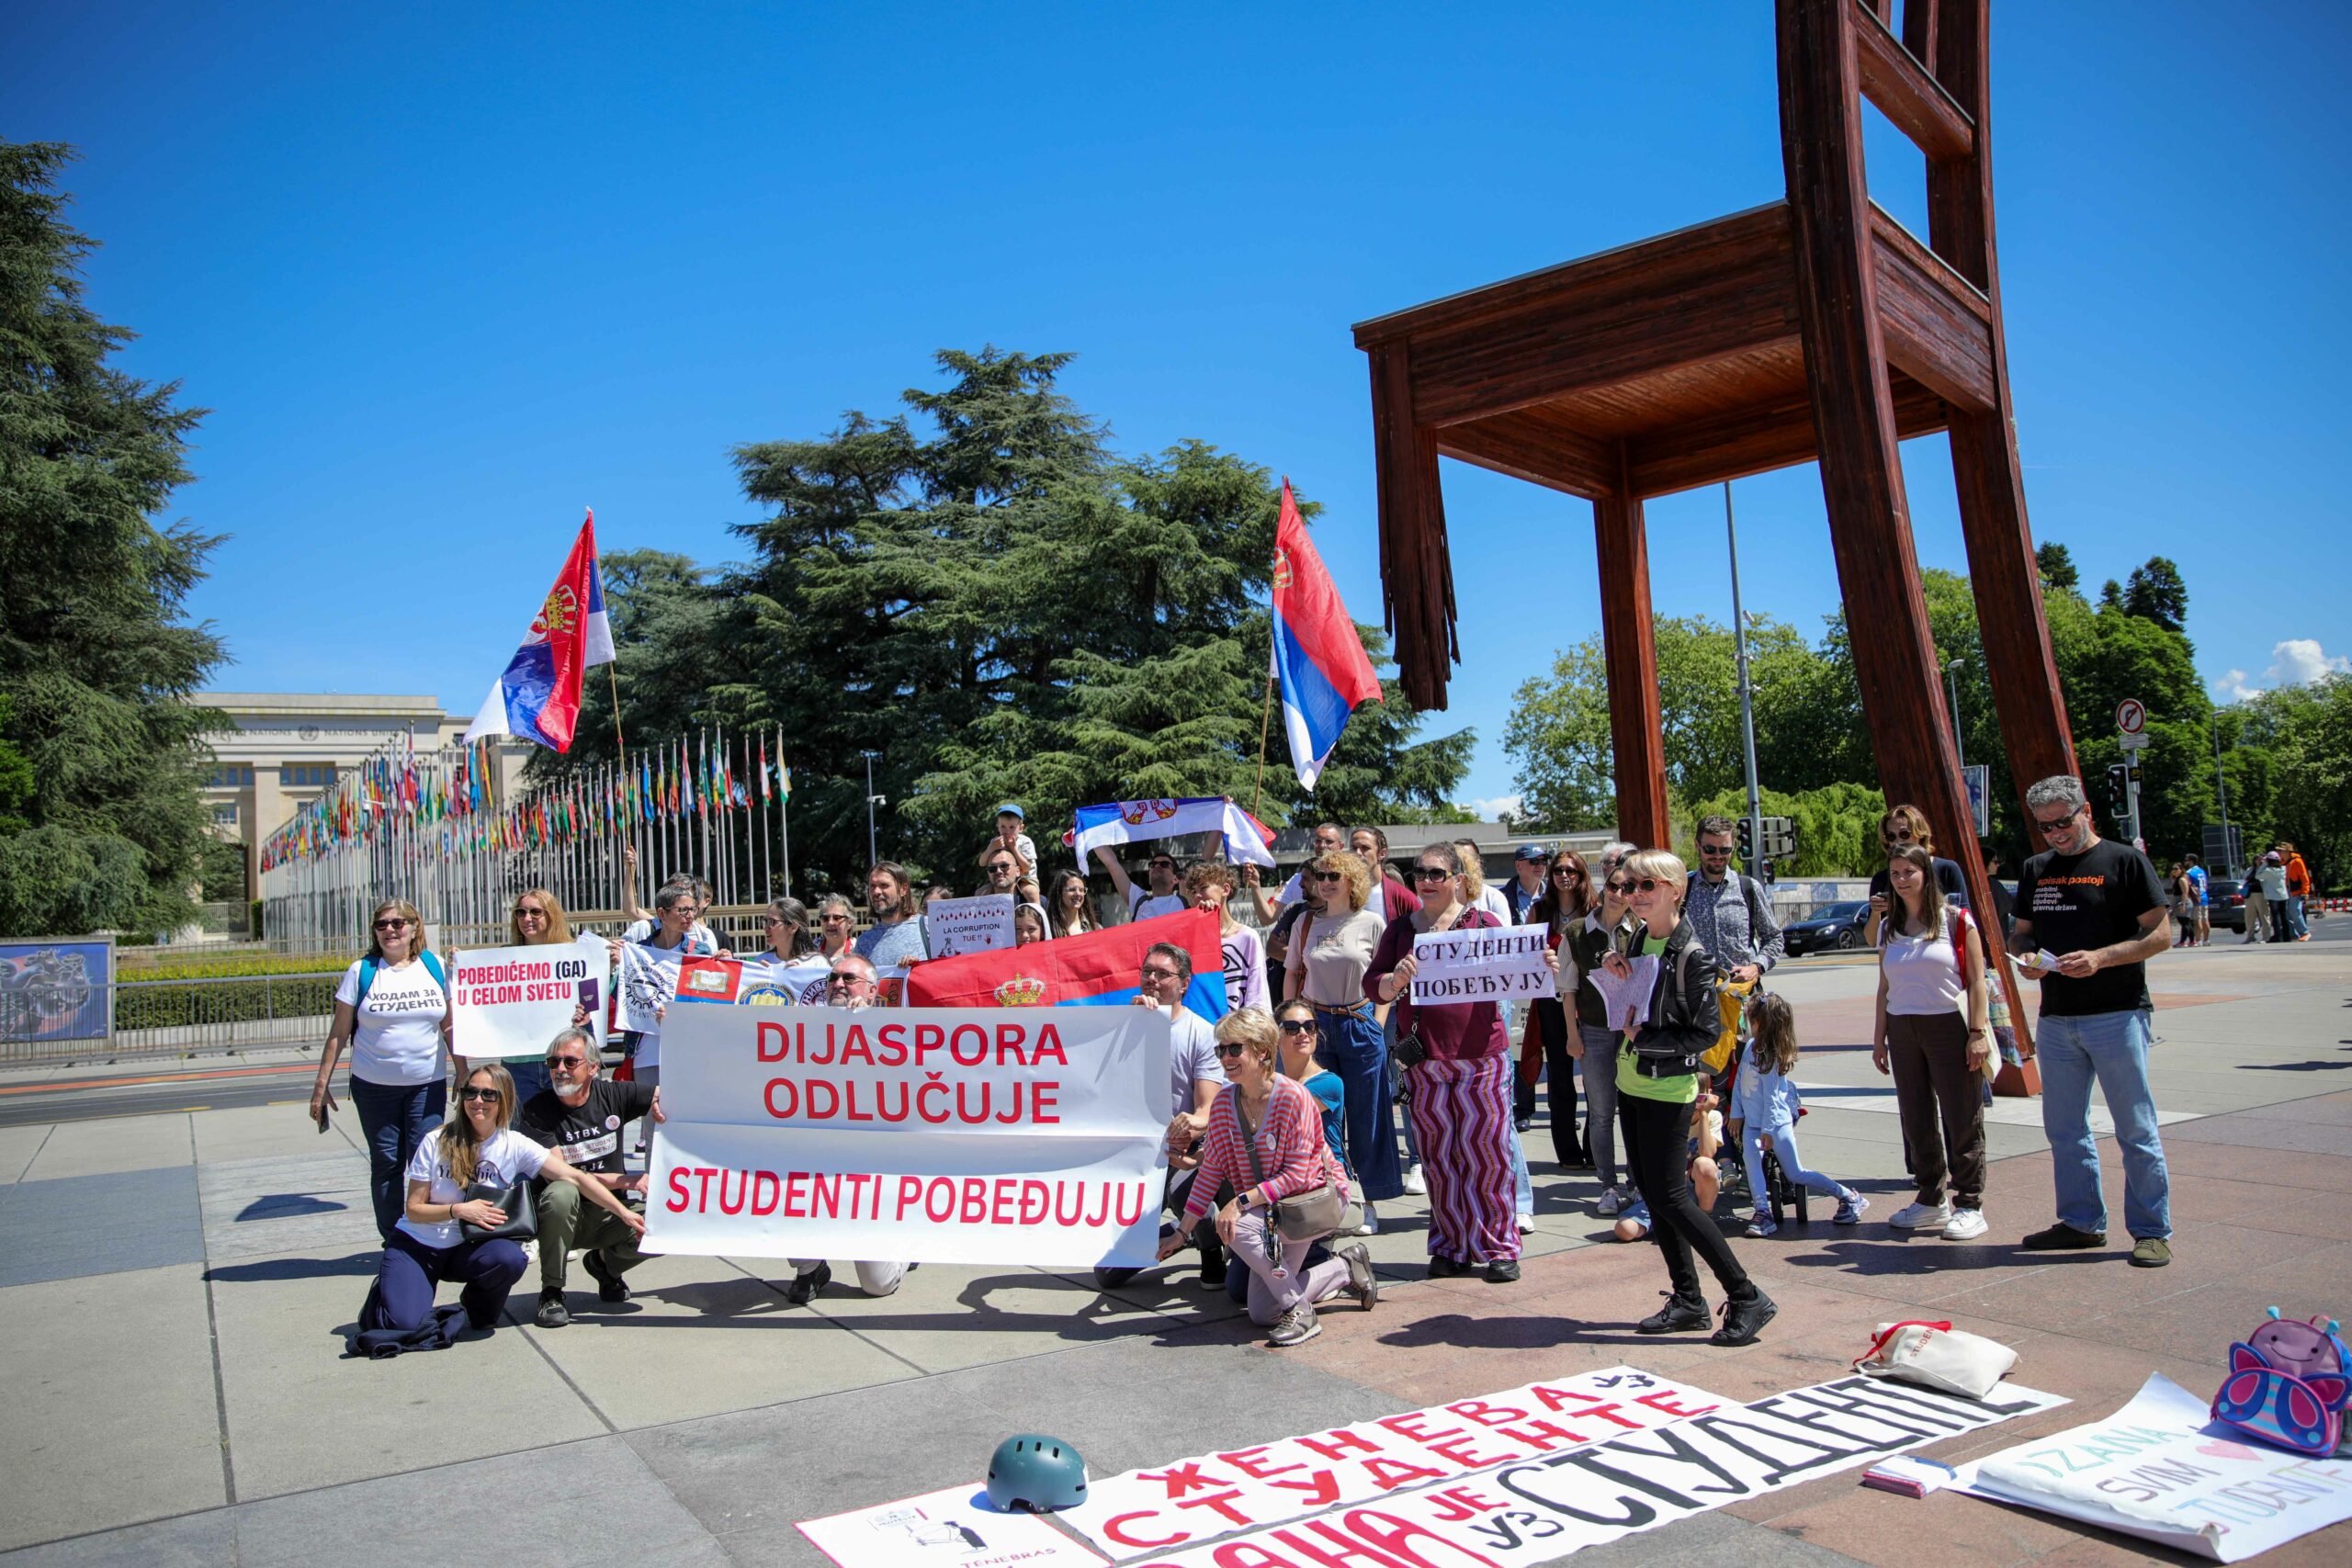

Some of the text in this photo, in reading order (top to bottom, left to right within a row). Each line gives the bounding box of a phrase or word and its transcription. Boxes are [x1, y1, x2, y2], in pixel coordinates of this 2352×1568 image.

[2038, 875, 2104, 886] spisak postoji
[953, 923, 1000, 932] CORRUPTION
[1415, 934, 1546, 962] СТУДЕНТИ
[458, 959, 587, 986] POBEDIĆEMO (GA)
[1414, 971, 1547, 998] ПОБЕЂУЈУ
[368, 998, 443, 1012] СТУДЕНТЕ
[371, 989, 437, 1001] ХОДАМ ЗА
[458, 989, 468, 1006] U
[471, 986, 522, 1006] CELOM
[526, 982, 571, 1002] SVETU
[756, 1021, 1069, 1066] DIJASPORA
[763, 1071, 1061, 1124] ODLUČUJE
[665, 1166, 1146, 1228] STUDENTI POBEĐUJU
[1136, 1386, 1608, 1499] ЖЕНЕВА
[1103, 1390, 1722, 1548] СТУДЕНТЕ
